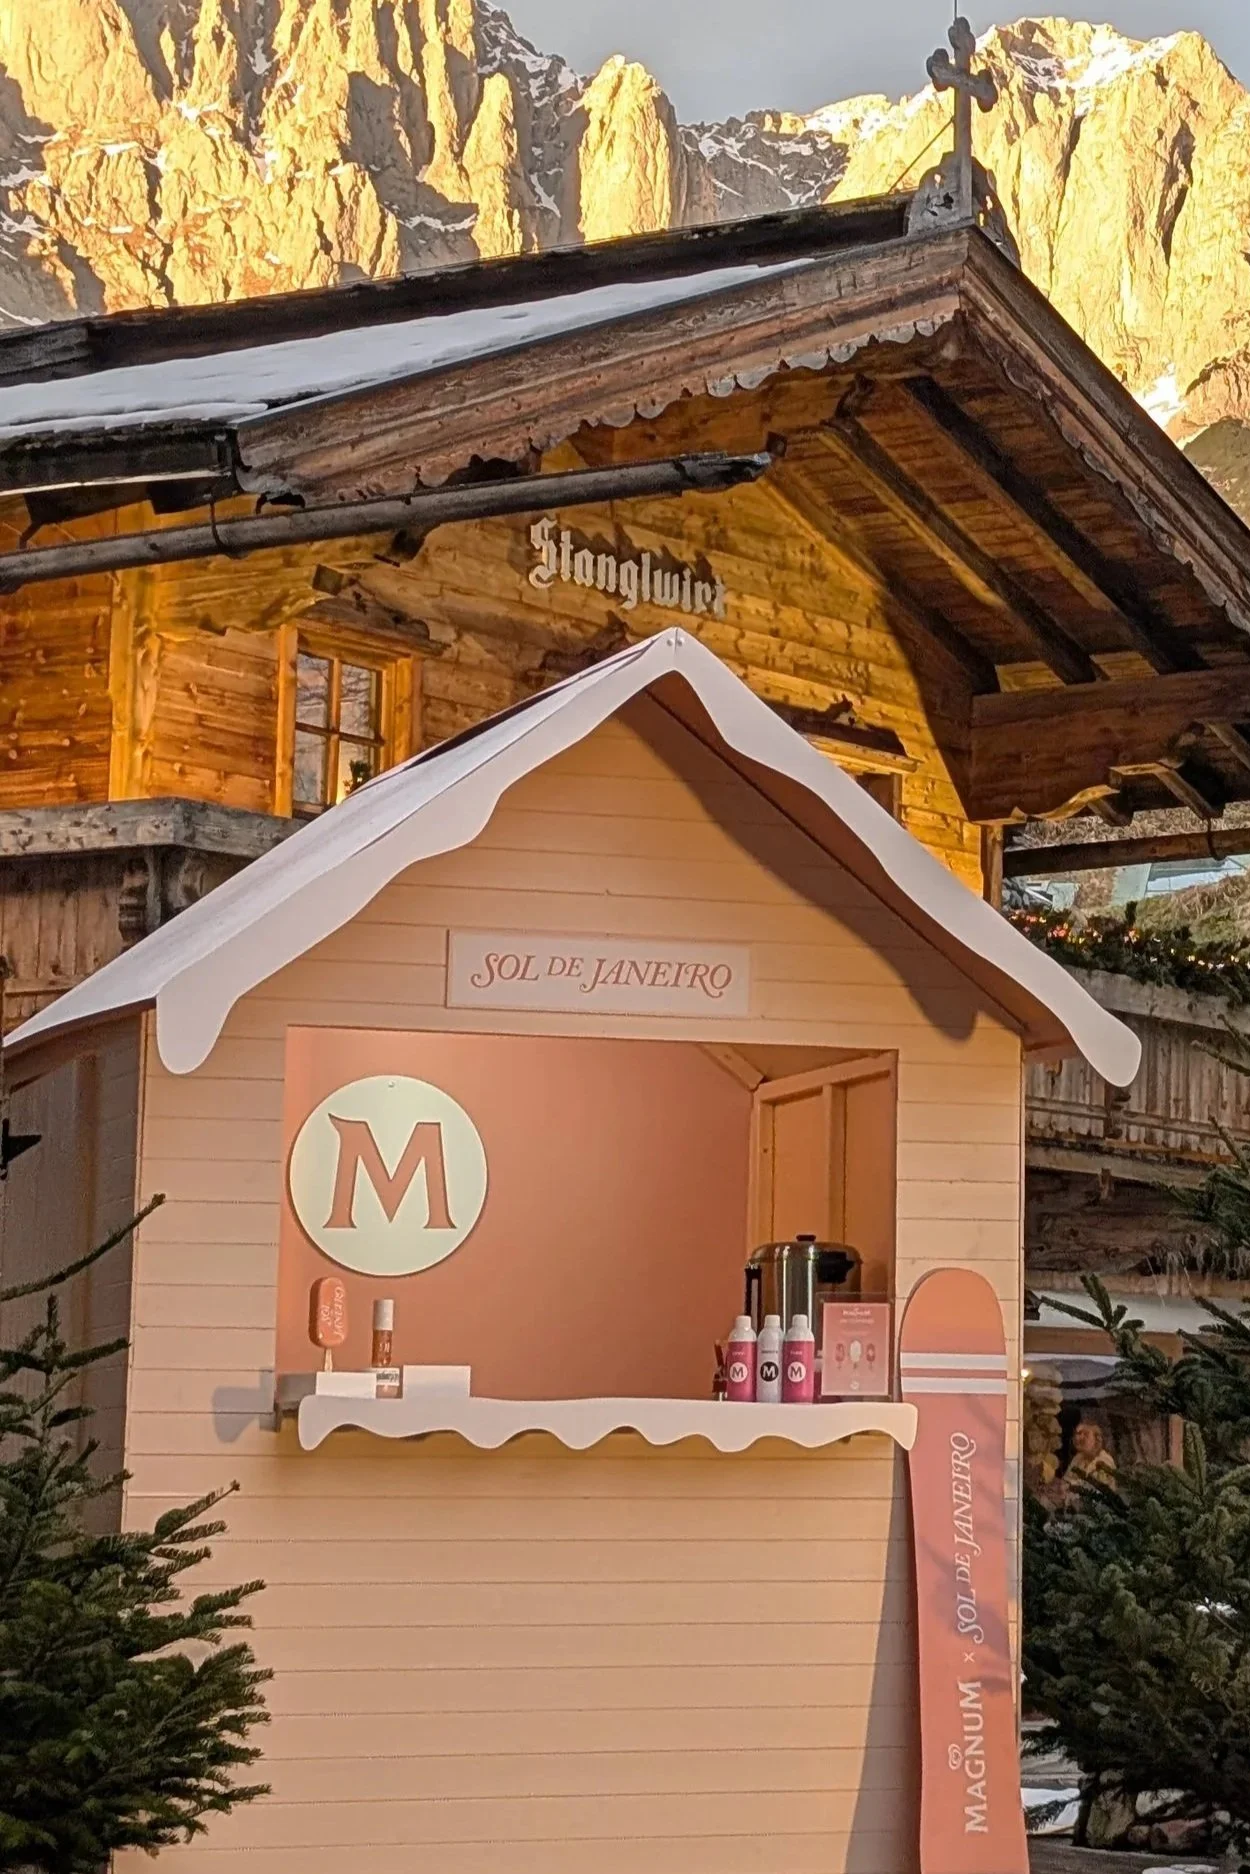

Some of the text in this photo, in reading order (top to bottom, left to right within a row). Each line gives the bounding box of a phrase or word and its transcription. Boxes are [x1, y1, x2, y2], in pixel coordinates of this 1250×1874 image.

[470, 953, 733, 998] SOL DE JANEIRO
[322, 1113, 457, 1229] M
[950, 1431, 980, 1557] JANEIRO
[956, 1553, 973, 1584] DE
[957, 1588, 984, 1644] SOL
[957, 1679, 988, 1833] MAGNUM
